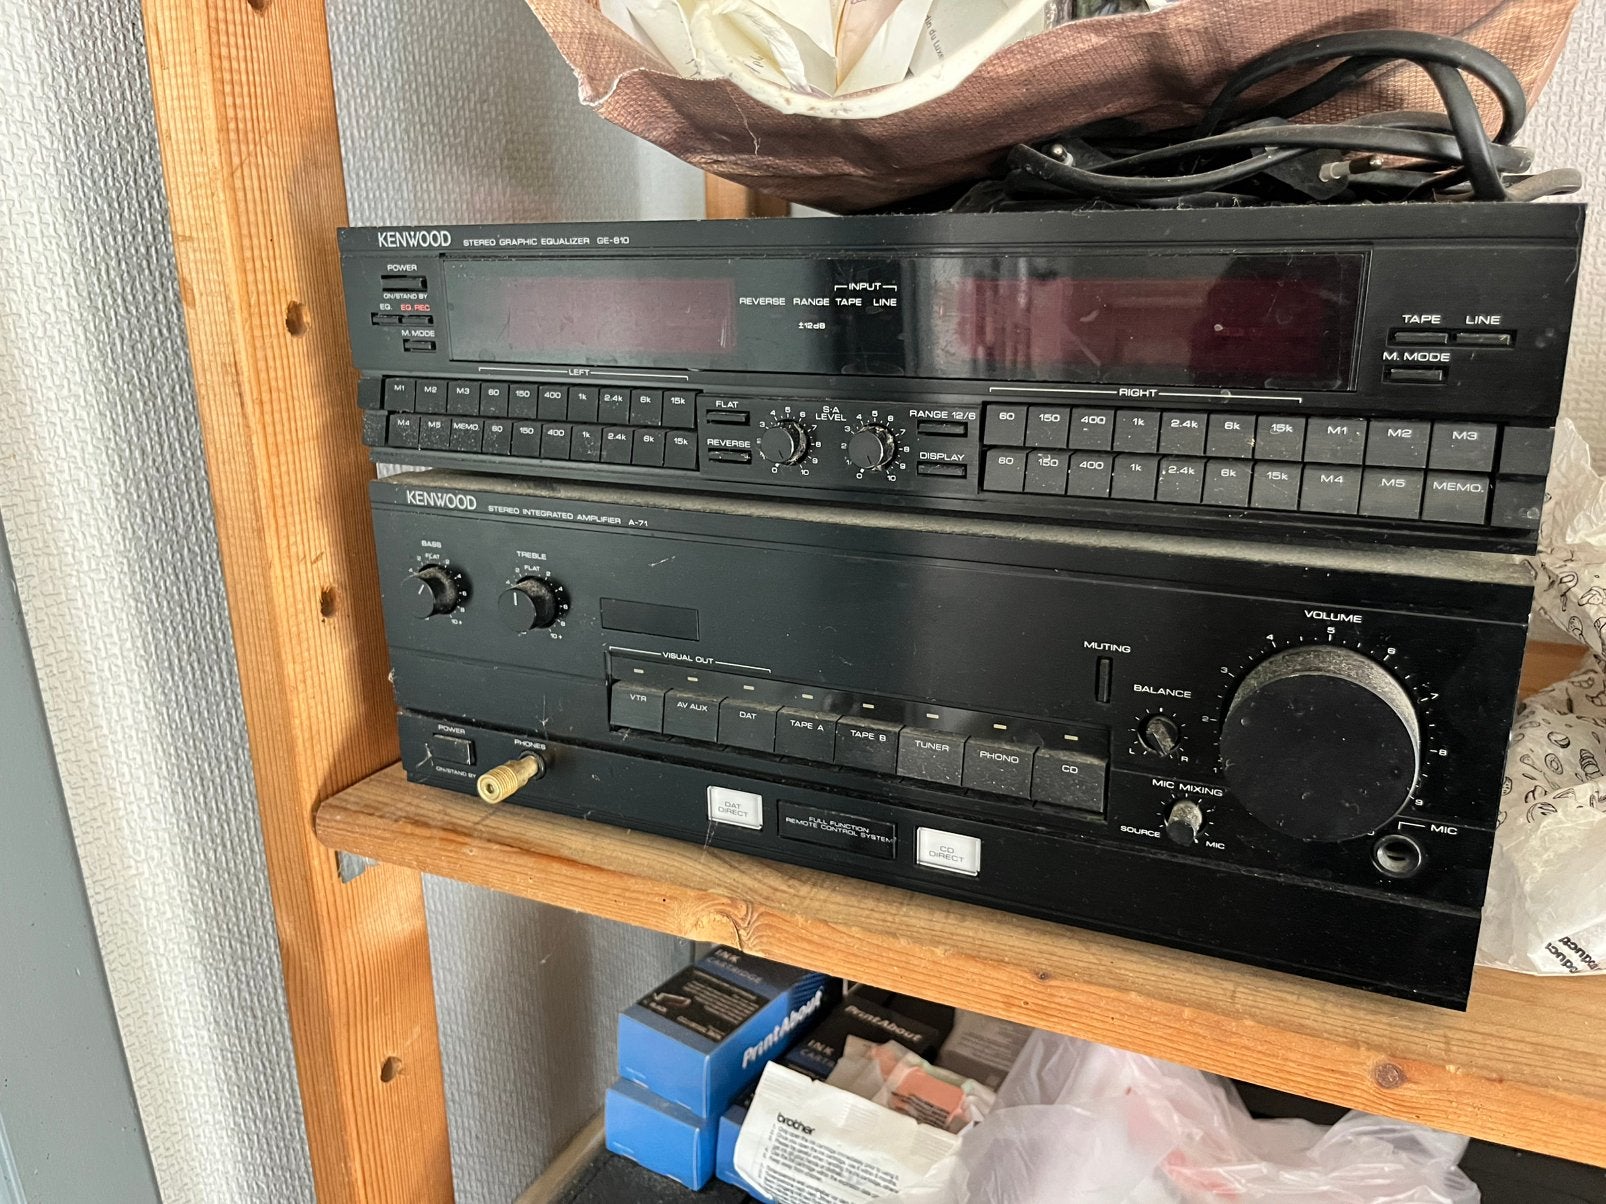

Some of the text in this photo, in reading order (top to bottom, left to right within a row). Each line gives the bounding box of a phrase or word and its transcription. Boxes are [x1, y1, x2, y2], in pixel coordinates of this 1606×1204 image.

[378, 231, 451, 248] KENWOOD
[463, 238, 496, 247] STEREO
[499, 237, 538, 246] GRAPHIC
[541, 237, 590, 246] EQUALIZER
[387, 264, 417, 272] POWER
[849, 283, 882, 291] INPUT
[739, 297, 786, 306] REVERSE
[793, 298, 830, 306] RANGE
[835, 298, 862, 307] TAPE
[873, 298, 897, 307] LINE
[414, 304, 431, 312] REC
[1402, 315, 1441, 324] TAPE
[1466, 315, 1501, 325] LINE
[1403, 353, 1451, 362] MODE
[567, 368, 590, 376] LEFT
[456, 387, 470, 395] M3
[515, 390, 530, 398] 150
[544, 391, 561, 399] 400
[1119, 388, 1157, 397] RIGHT
[604, 394, 623, 403] 2.4k
[640, 396, 651, 404] 6k
[670, 397, 686, 405] 15k
[716, 401, 739, 409] FLAT
[815, 413, 847, 422] LEVEL
[909, 410, 976, 420] RANGE 12/6
[999, 412, 1015, 420] 60
[1039, 413, 1060, 422] 150
[397, 419, 410, 427] M4
[428, 421, 441, 429] M5
[1081, 416, 1106, 425] 400
[1132, 417, 1145, 426] 1k
[1171, 419, 1198, 429] 2.4k
[453, 422, 480, 431] MEMO.
[519, 426, 534, 434] 150
[1225, 421, 1241, 430] 6k
[1271, 424, 1293, 433] 15k
[547, 428, 565, 437] 400
[1327, 426, 1347, 435] M1
[1388, 428, 1412, 438] M2
[607, 432, 627, 441] 2.4k
[643, 435, 655, 443] 6k
[674, 436, 689, 445] 15k
[1452, 431, 1478, 441] M3
[707, 439, 751, 448] REVERSE
[920, 452, 965, 462] DISPLAY
[998, 457, 1014, 465] 60
[1038, 458, 1059, 467] 150
[1079, 461, 1104, 470] 400
[1130, 463, 1142, 472] 1k
[1168, 465, 1195, 475] 2.4k
[1221, 468, 1237, 477] 6k
[1266, 472, 1288, 481] 15k
[1320, 474, 1343, 484] M4
[1381, 478, 1406, 488] M5
[1433, 481, 1484, 493] MEMO.
[407, 490, 477, 510] KENWOOD
[488, 505, 648, 527] STEREO INTEGRATED AMPLIFIER A-71
[421, 540, 442, 549] BASS
[516, 550, 547, 561] TREBLE
[1304, 610, 1363, 624] VOLUME
[1083, 640, 1131, 653] MUTING
[1387, 647, 1396, 655] 6
[662, 652, 714, 665] VISUAL OUT
[1220, 666, 1228, 674] 3
[1133, 684, 1192, 699] BALANCE
[1430, 692, 1439, 700] 7
[629, 694, 647, 702] VTR
[676, 701, 708, 712] AV AUX
[739, 711, 757, 720] DAT
[438, 724, 465, 734] POWER
[790, 720, 813, 730] TAPE
[850, 730, 875, 740] TAPE
[514, 739, 546, 750] PHONES
[915, 740, 950, 752] TUNER
[979, 751, 1019, 764] PHONO
[1061, 765, 1079, 774] CD
[1152, 778, 1223, 797] MIC MIXING
[725, 801, 741, 809] DAT
[718, 806, 748, 818] DIRECT
[808, 816, 870, 833] FULL FUNCTION
[785, 817, 893, 843] REMOTE CONTROL SYSTEM
[1120, 826, 1161, 838] SOURCE
[1431, 824, 1458, 835] MIC
[939, 845, 955, 854] CD
[1205, 840, 1226, 850] MIC
[928, 850, 965, 864] DIRECT
[714, 949, 740, 964] INK
[742, 986, 825, 1069] PrintAbout
[845, 1005, 923, 1043] PrintAbout
[807, 1039, 835, 1056] INK
[777, 1112, 815, 1135] brother
